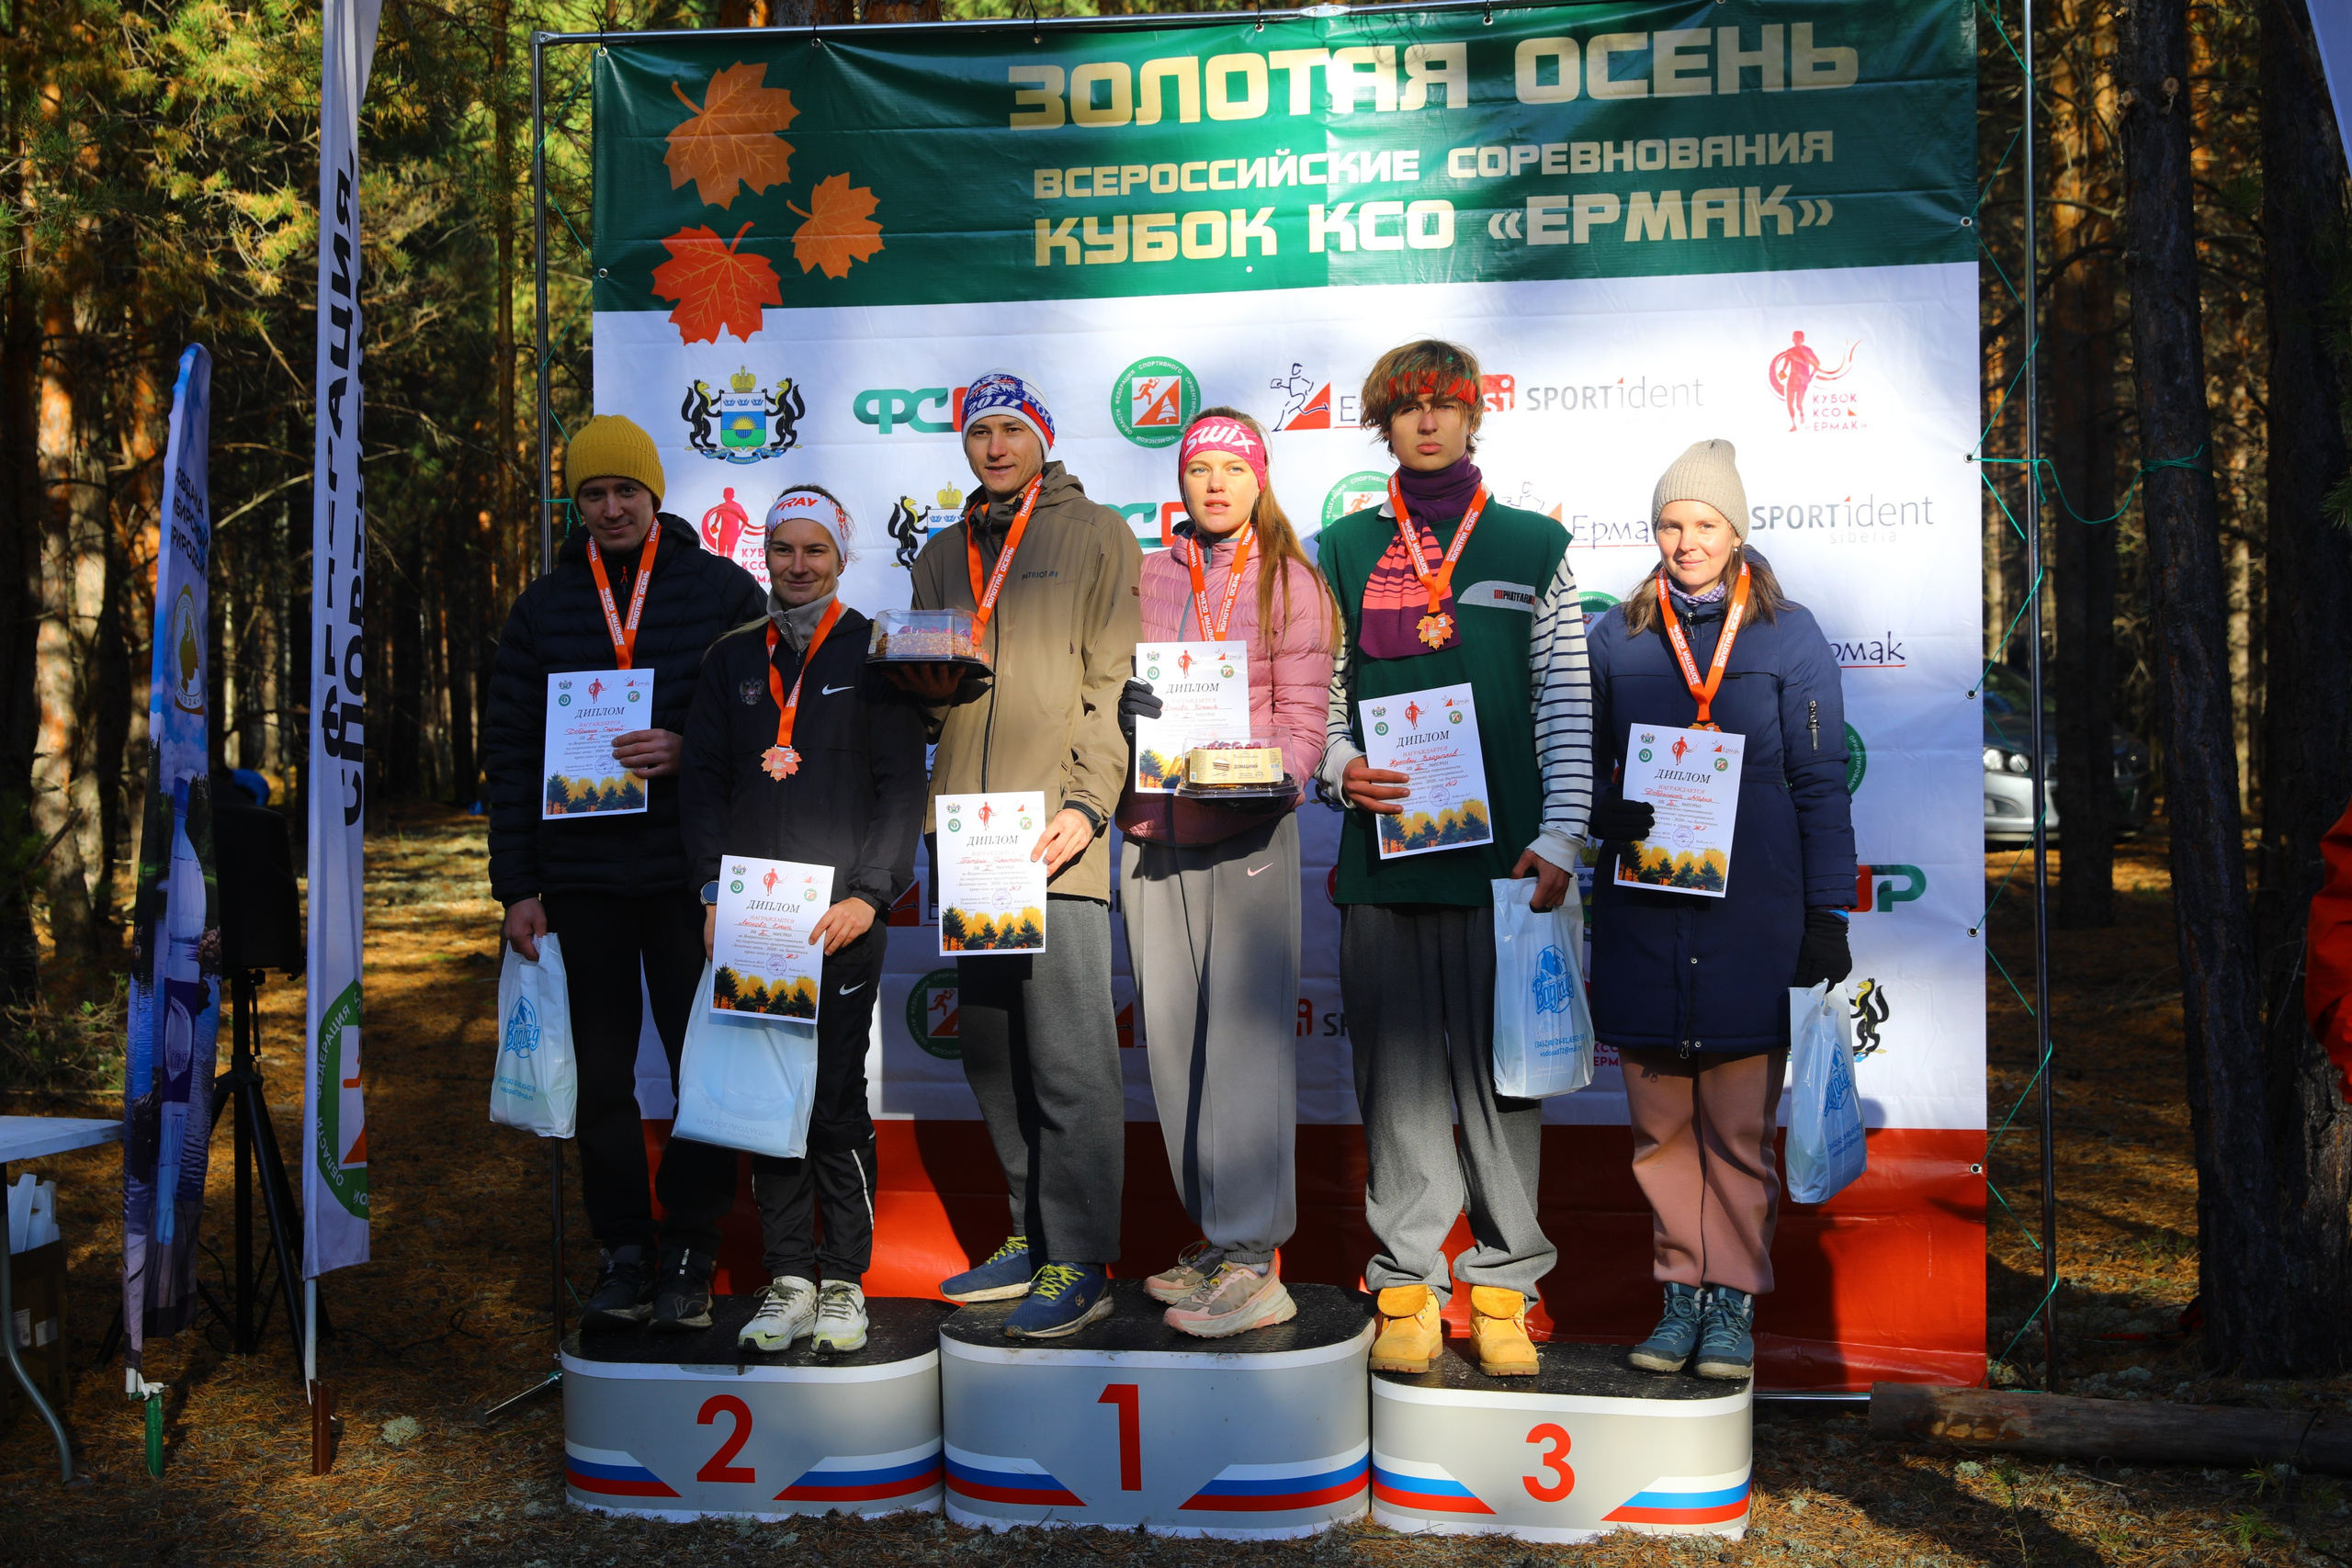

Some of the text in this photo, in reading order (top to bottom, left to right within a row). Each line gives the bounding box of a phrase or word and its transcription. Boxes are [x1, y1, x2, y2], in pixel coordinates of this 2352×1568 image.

[1008, 22, 1859, 130] ЗОЛОТАЯ ОСЕНЬ
[1035, 130, 1834, 199] ВСЕРОССИЙСКИЕ СОРЕВНОВАНИЯ
[1035, 185, 1834, 266] КУБОК КСО «ЕРМАК»
[1138, 360, 1182, 374] СПОРТИВНОГО
[1814, 394, 1857, 404] КУБОК
[1814, 408, 1840, 417] КСО
[1020, 488, 1037, 517] ТЮМЕНЬ
[1405, 519, 1417, 541] ОСЕНЬ
[1465, 511, 1478, 531] ОСЕНЬ
[1572, 515, 1655, 549] Ерма
[741, 547, 765, 558] КУБ
[1001, 547, 1014, 572] ОСЕНЬ
[639, 570, 650, 594] ОСЕНЬ
[1229, 573, 1240, 596] ОСЕНЬ
[605, 588, 615, 611] ОСЕНЬ
[1200, 591, 1209, 614] ОСЕНЬ
[1438, 617, 1446, 627] 3
[1730, 604, 1743, 630] ОСЕНЬ
[1674, 625, 1686, 650] ОСЕНЬ
[1166, 683, 1219, 694] ДИПЛОМ
[574, 706, 625, 719] ДИПЛОМ
[1396, 730, 1450, 749] ДИПЛОМ
[785, 752, 794, 762] 2
[1403, 746, 1448, 758] НАГРАЖДАЕТСЯ
[1654, 769, 1712, 784] ДИПЛОМ
[1657, 784, 1705, 795] НАГРАЖДАЕТСЯ
[967, 835, 1018, 847] ДИПЛОМ
[746, 900, 800, 914] ДИПЛОМ
[750, 915, 795, 924] НАГРАЖДАЕТСЯ
[697, 1118, 775, 1139] КАТАЛОГ ПРОДУКЦИИ
[696, 1394, 755, 1483] 2
[1097, 1383, 1141, 1491] 1
[1522, 1423, 1576, 1503] 3
